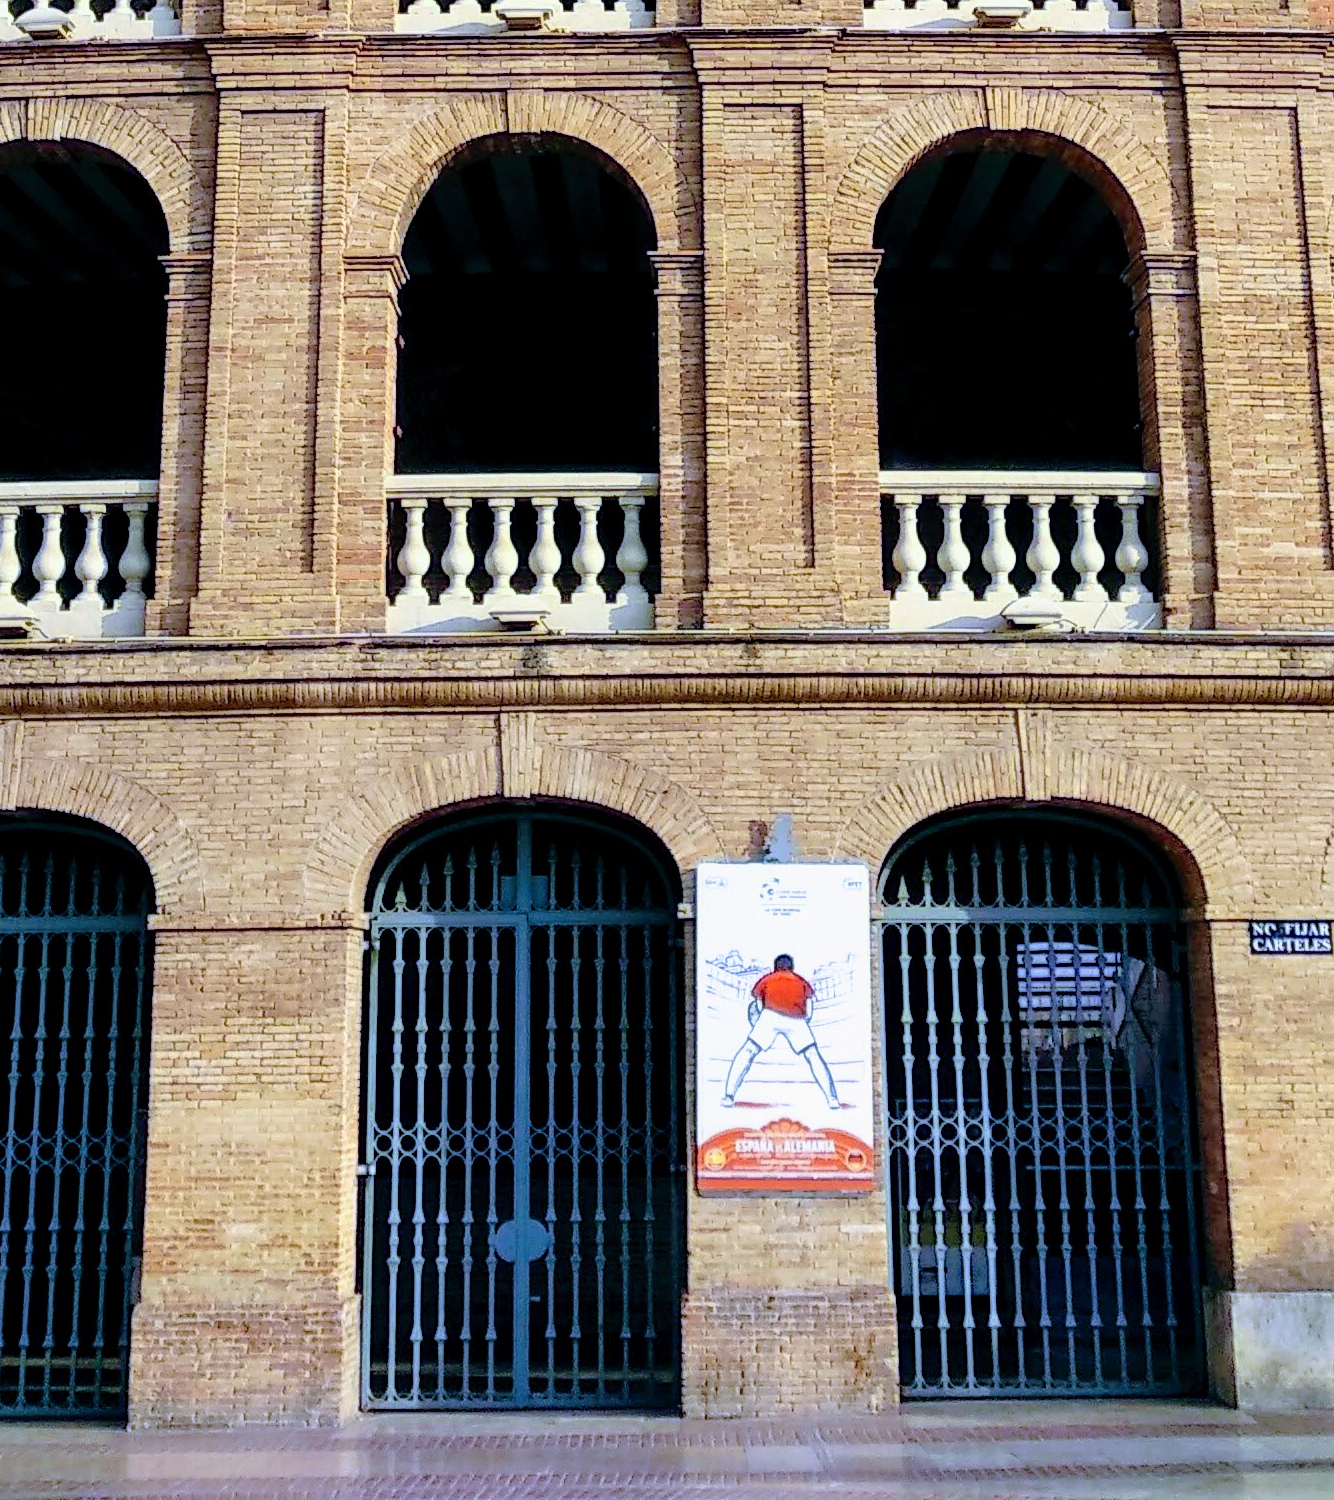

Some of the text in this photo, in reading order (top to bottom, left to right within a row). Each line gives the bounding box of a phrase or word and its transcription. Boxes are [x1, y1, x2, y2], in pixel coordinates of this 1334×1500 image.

[1283, 922, 1330, 937] FIJAR
[1252, 937, 1332, 952] CARTELES
[735, 1137, 774, 1154] ESPAÑA
[784, 1139, 836, 1154] ALEMANIA
